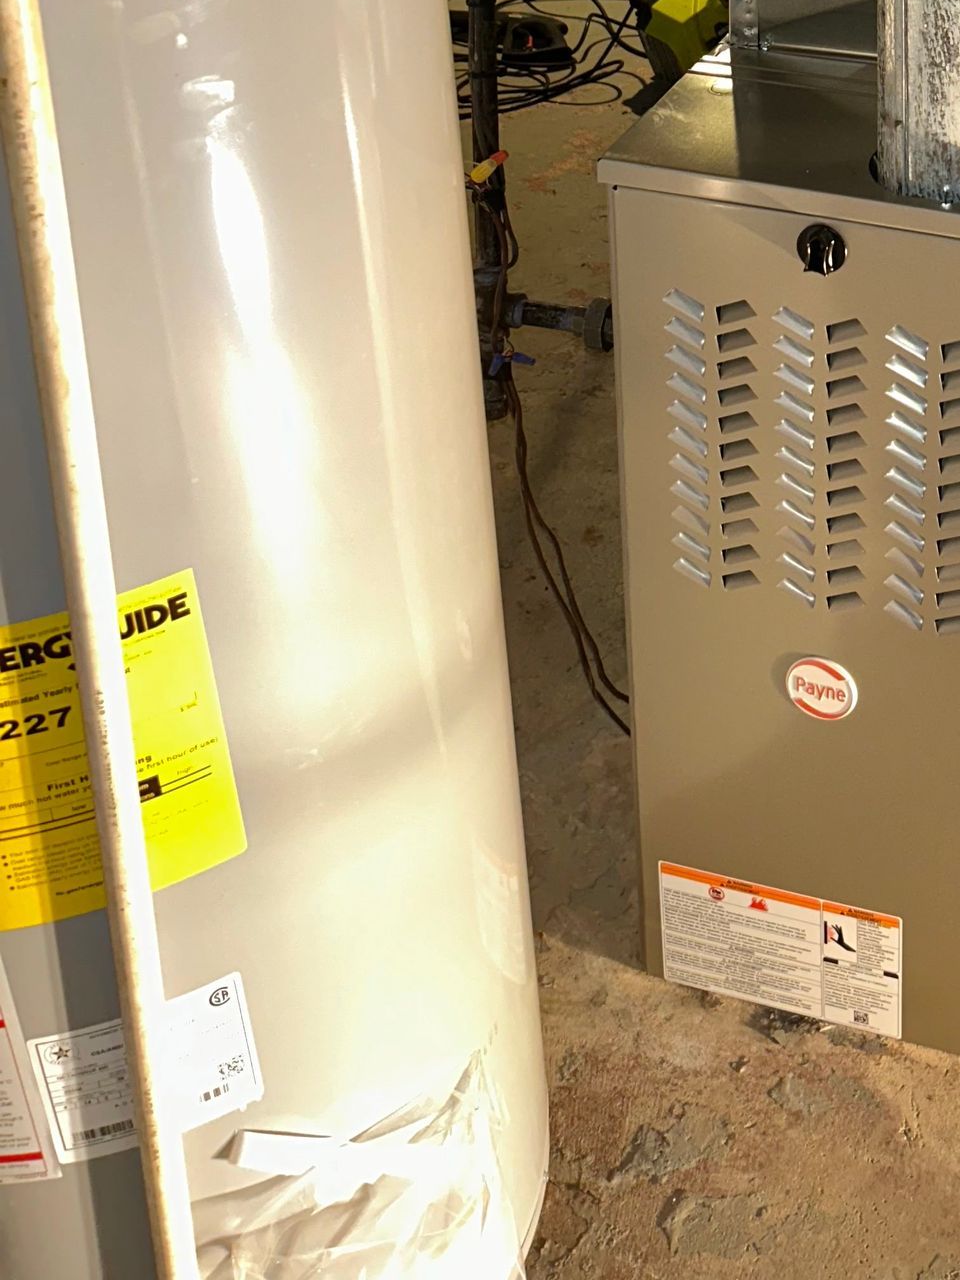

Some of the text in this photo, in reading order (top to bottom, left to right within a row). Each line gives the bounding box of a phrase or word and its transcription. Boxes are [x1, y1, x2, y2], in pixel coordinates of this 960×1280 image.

[0, 631, 72, 673] ERG
[795, 675, 846, 703] Payne
[47, 779, 76, 791] First
